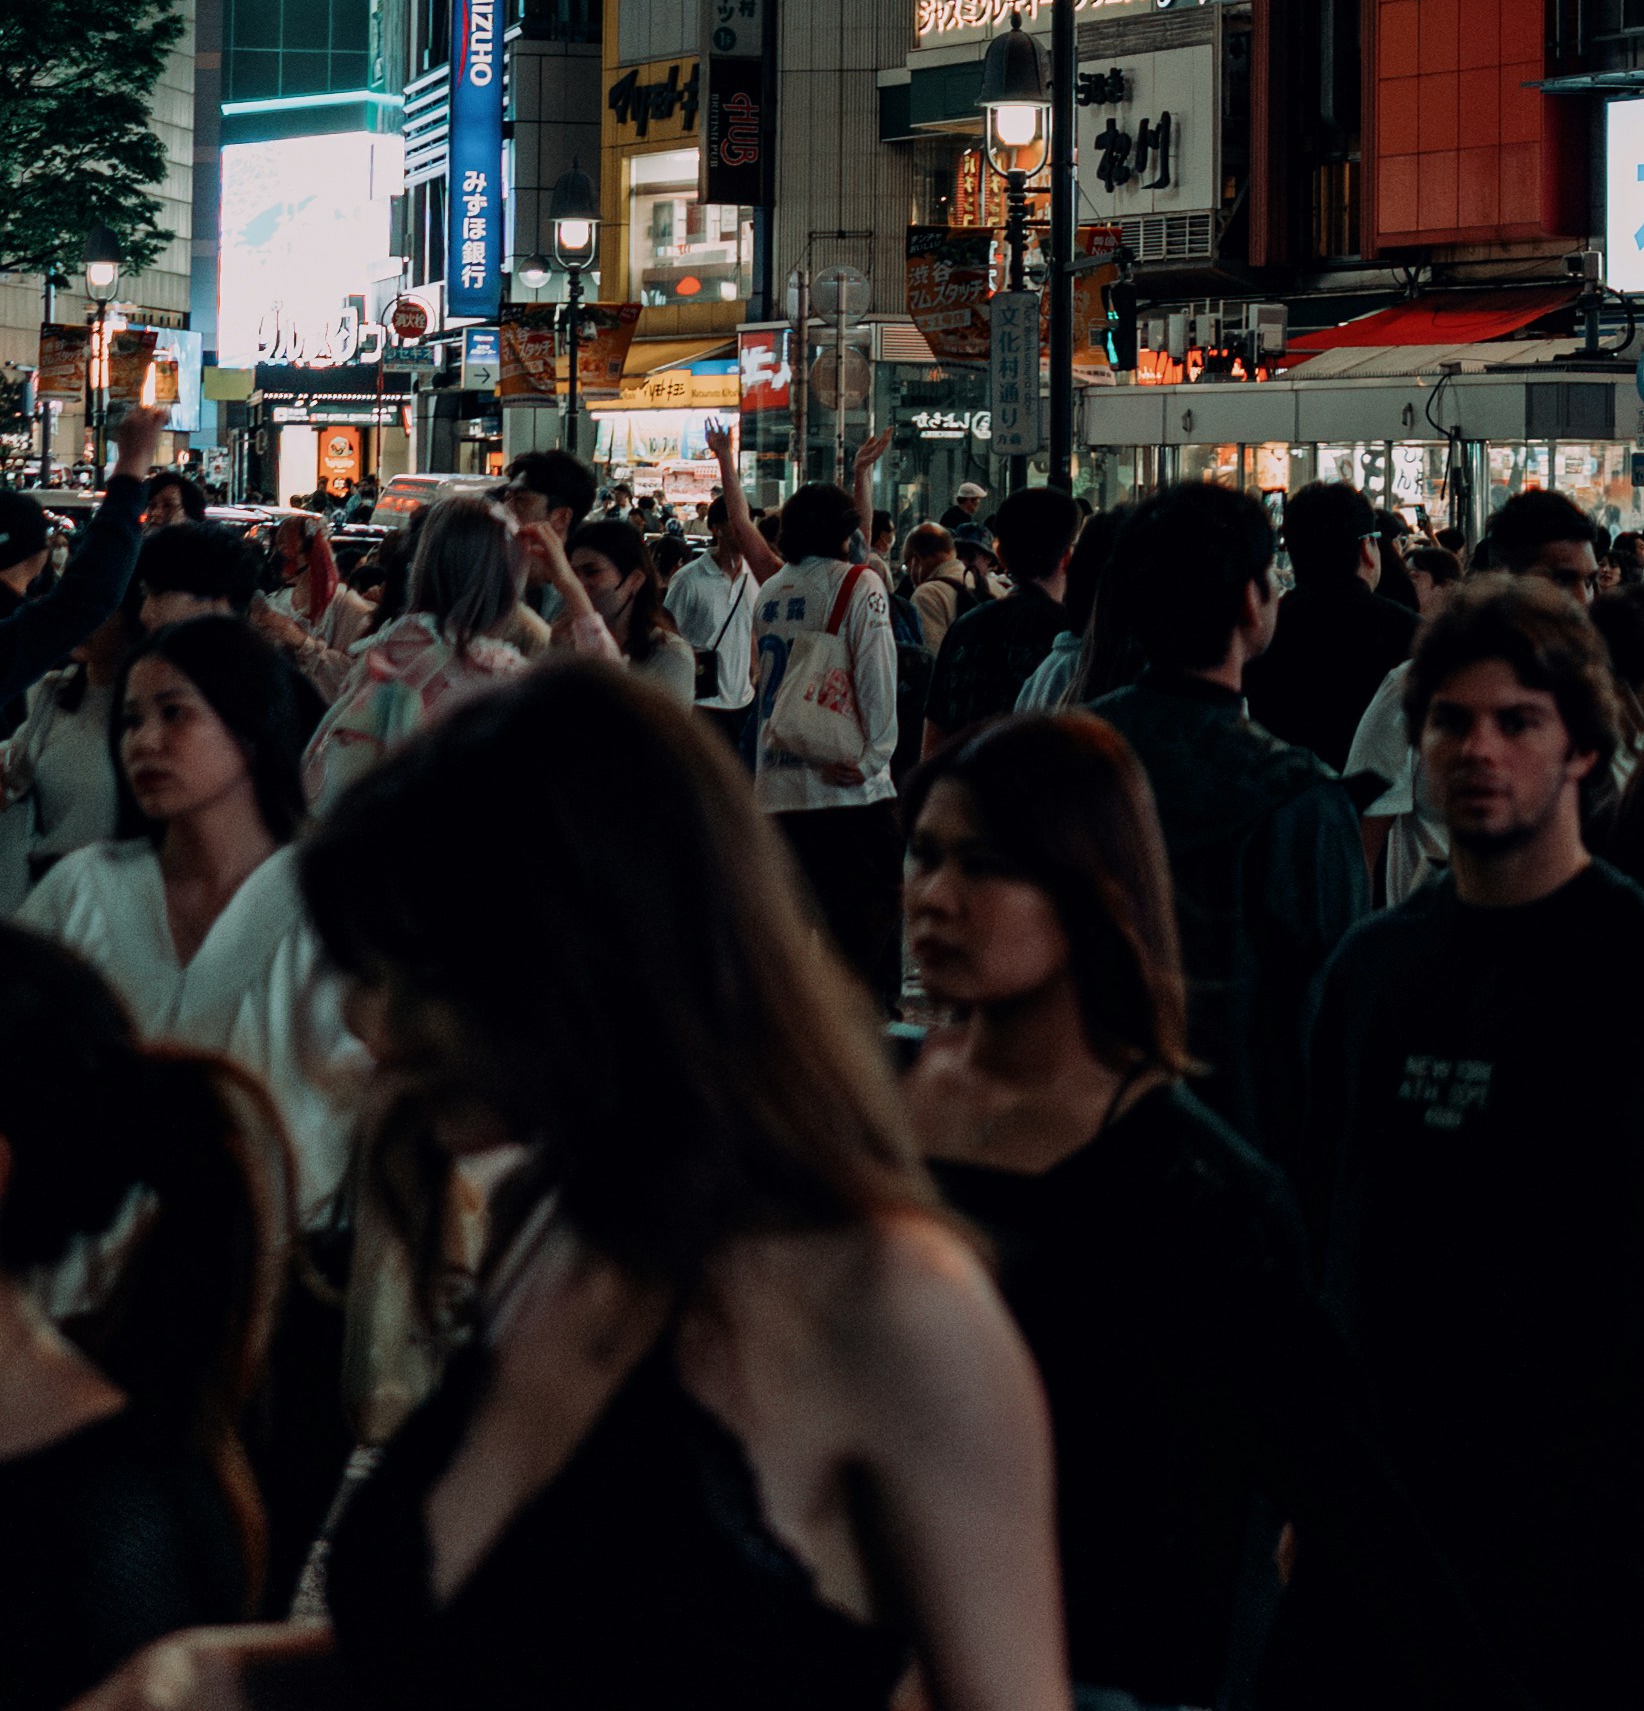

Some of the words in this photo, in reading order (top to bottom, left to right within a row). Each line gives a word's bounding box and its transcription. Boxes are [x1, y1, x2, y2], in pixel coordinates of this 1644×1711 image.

[721, 91, 760, 167] HUB
[710, 142, 719, 168] PUB
[461, 170, 488, 290] みずほ銀行
[908, 260, 953, 286] 渋谷
[394, 314, 427, 330] 消火栓
[998, 304, 1019, 428] 文化村通り
